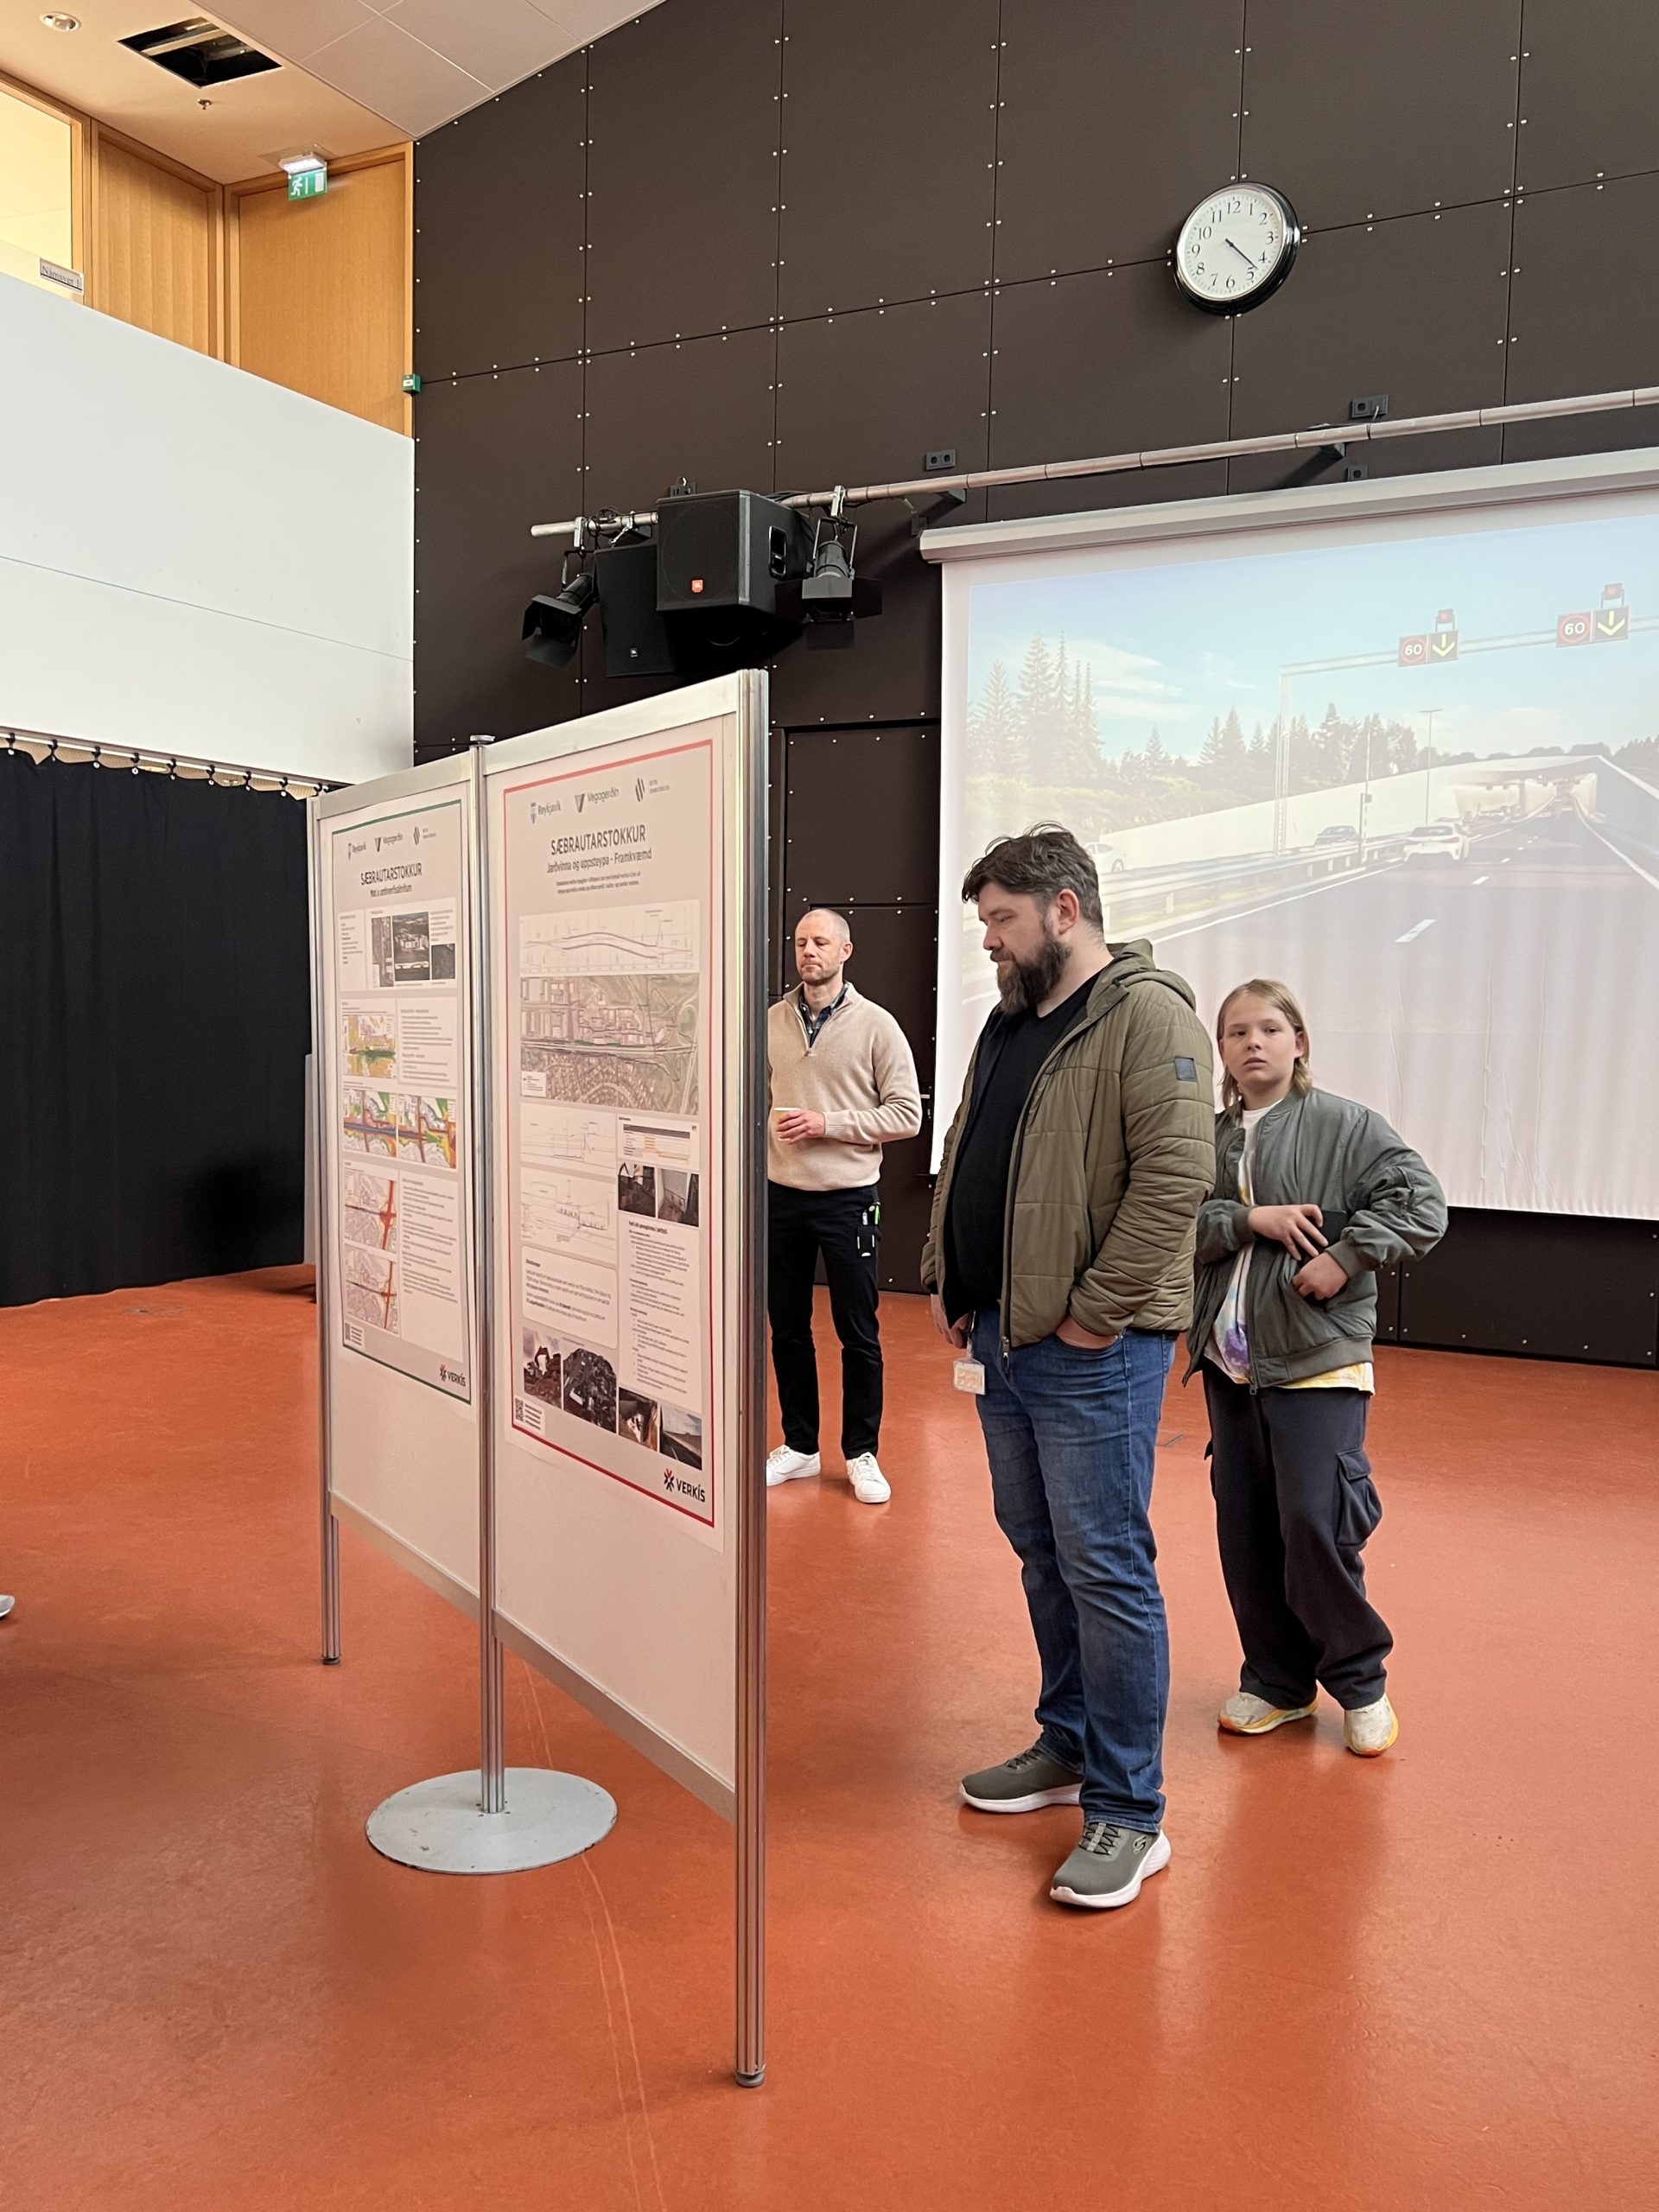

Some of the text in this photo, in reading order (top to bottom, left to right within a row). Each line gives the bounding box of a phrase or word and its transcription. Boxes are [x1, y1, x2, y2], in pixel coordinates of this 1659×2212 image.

[1227, 200, 1241, 214] 12
[1211, 209, 1222, 223] 11
[1259, 213, 1268, 226] 2
[1198, 226, 1212, 240] 10
[1266, 231, 1274, 245] 3
[1192, 244, 1201, 257] 9
[1258, 250, 1267, 264] 4
[1196, 262, 1205, 276] 8
[1247, 266, 1255, 280] 5
[1211, 273, 1218, 286] 7
[1225, 274, 1236, 289] 6
[1563, 622, 1585, 635] 60
[1404, 645, 1422, 656] 60
[550, 824, 646, 855] SÆBRAUTARSTOKKUR
[573, 861, 580, 872] og
[581, 856, 610, 871] uppsteypa
[614, 848, 652, 864] Framkvæmd
[360, 862, 423, 886] SÆBRAUTARSTOKKUR
[676, 1478, 706, 1503] VERKÍS
